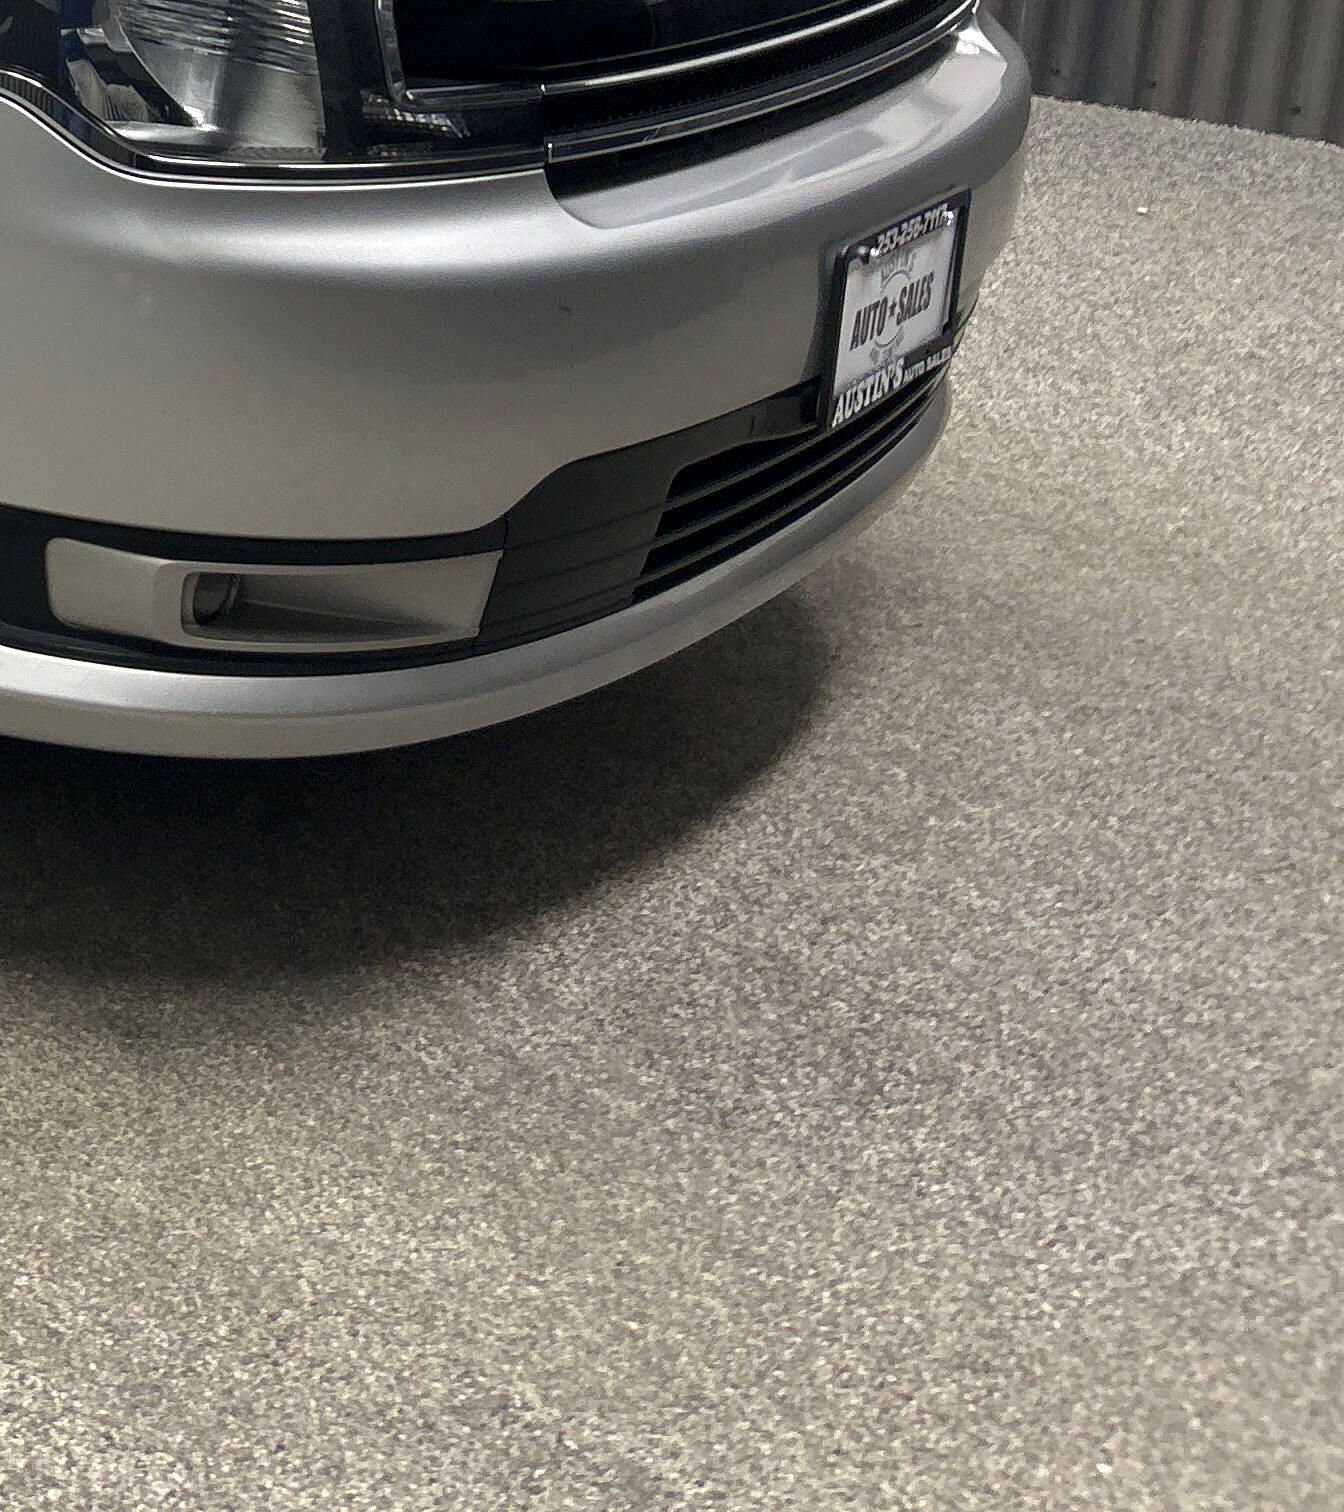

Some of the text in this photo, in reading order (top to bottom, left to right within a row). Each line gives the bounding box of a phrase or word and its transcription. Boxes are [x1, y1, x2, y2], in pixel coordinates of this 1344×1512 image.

[849, 295, 888, 351] AUTO
[896, 271, 934, 326] SALES
[831, 355, 905, 429] AUSTIN'S
